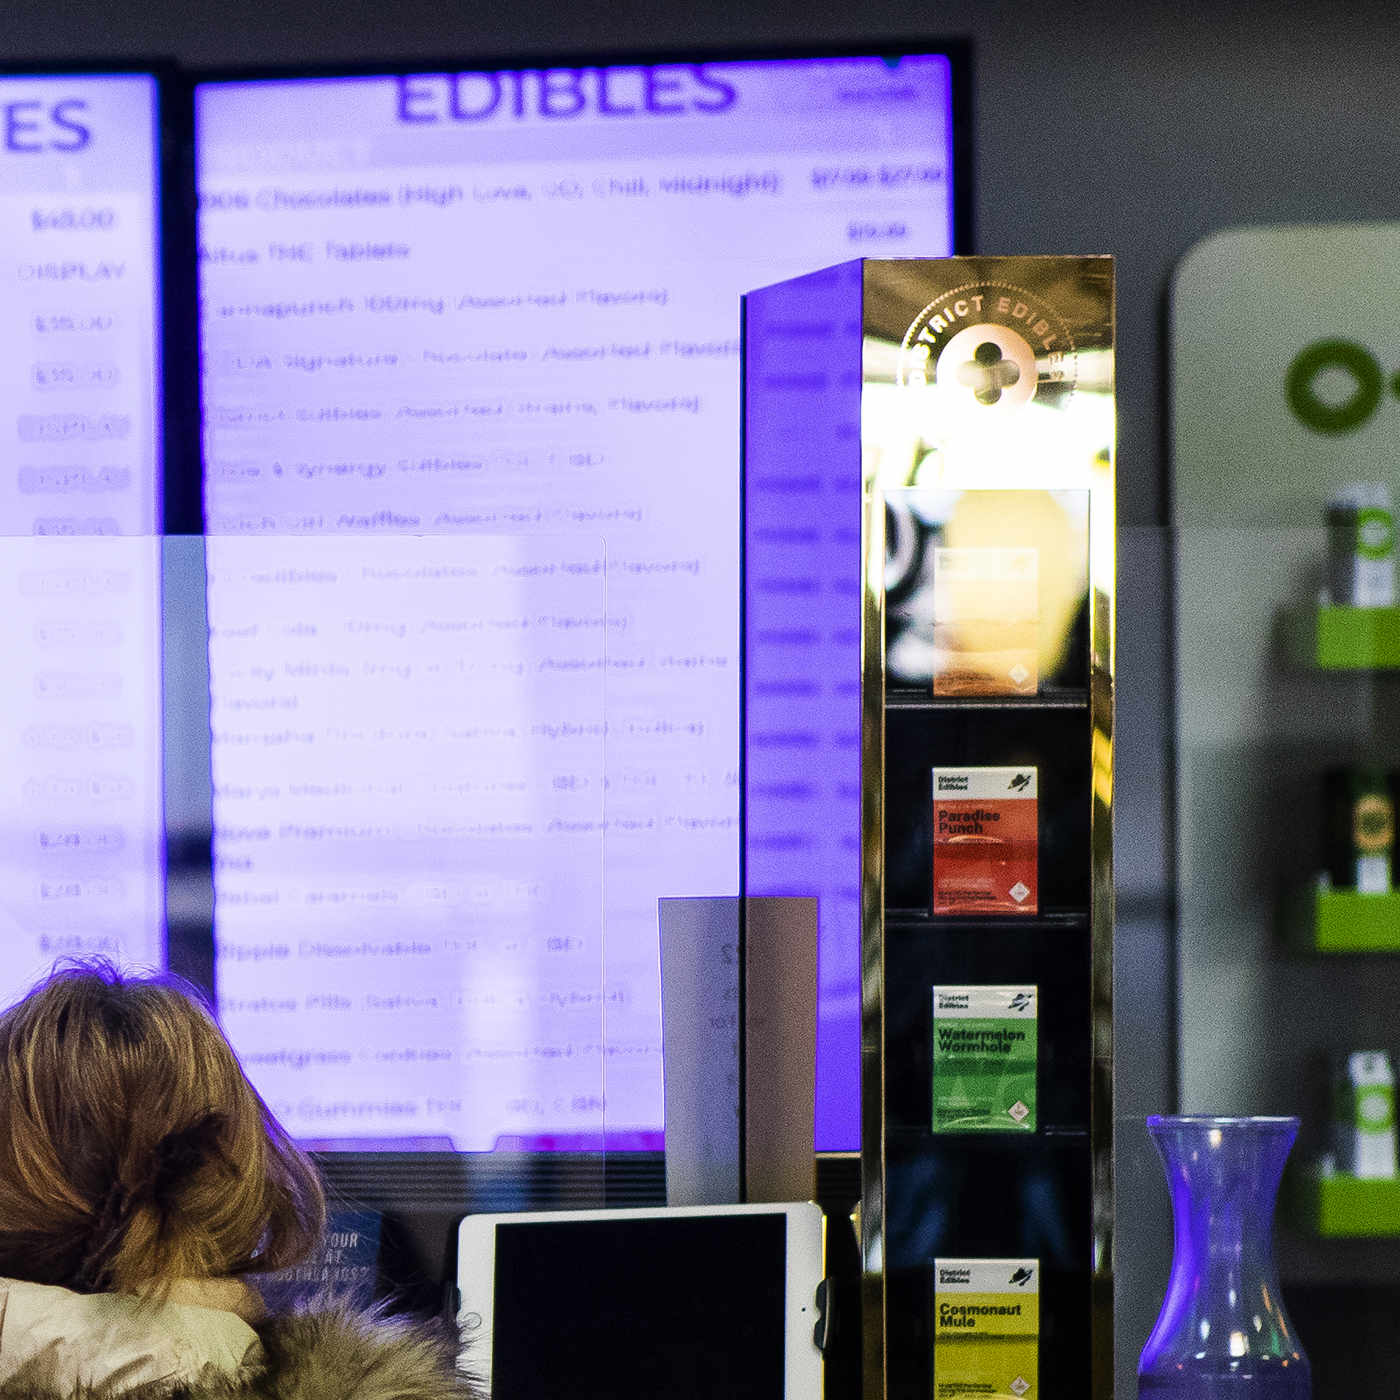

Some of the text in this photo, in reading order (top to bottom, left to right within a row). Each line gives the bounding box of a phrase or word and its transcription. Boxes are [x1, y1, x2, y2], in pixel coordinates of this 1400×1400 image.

[397, 60, 741, 125] EDIBLES
[906, 294, 985, 387] DISTRICT
[938, 783, 969, 791] Edibles
[938, 810, 1001, 822] Paradise
[938, 822, 983, 834] Punch
[938, 1027, 1025, 1041] Watermelon
[938, 1040, 1011, 1052] Wormhole
[939, 1276, 970, 1284] Edibles
[939, 1303, 1022, 1316] Cosmonaut
[939, 1315, 976, 1327] Mule
